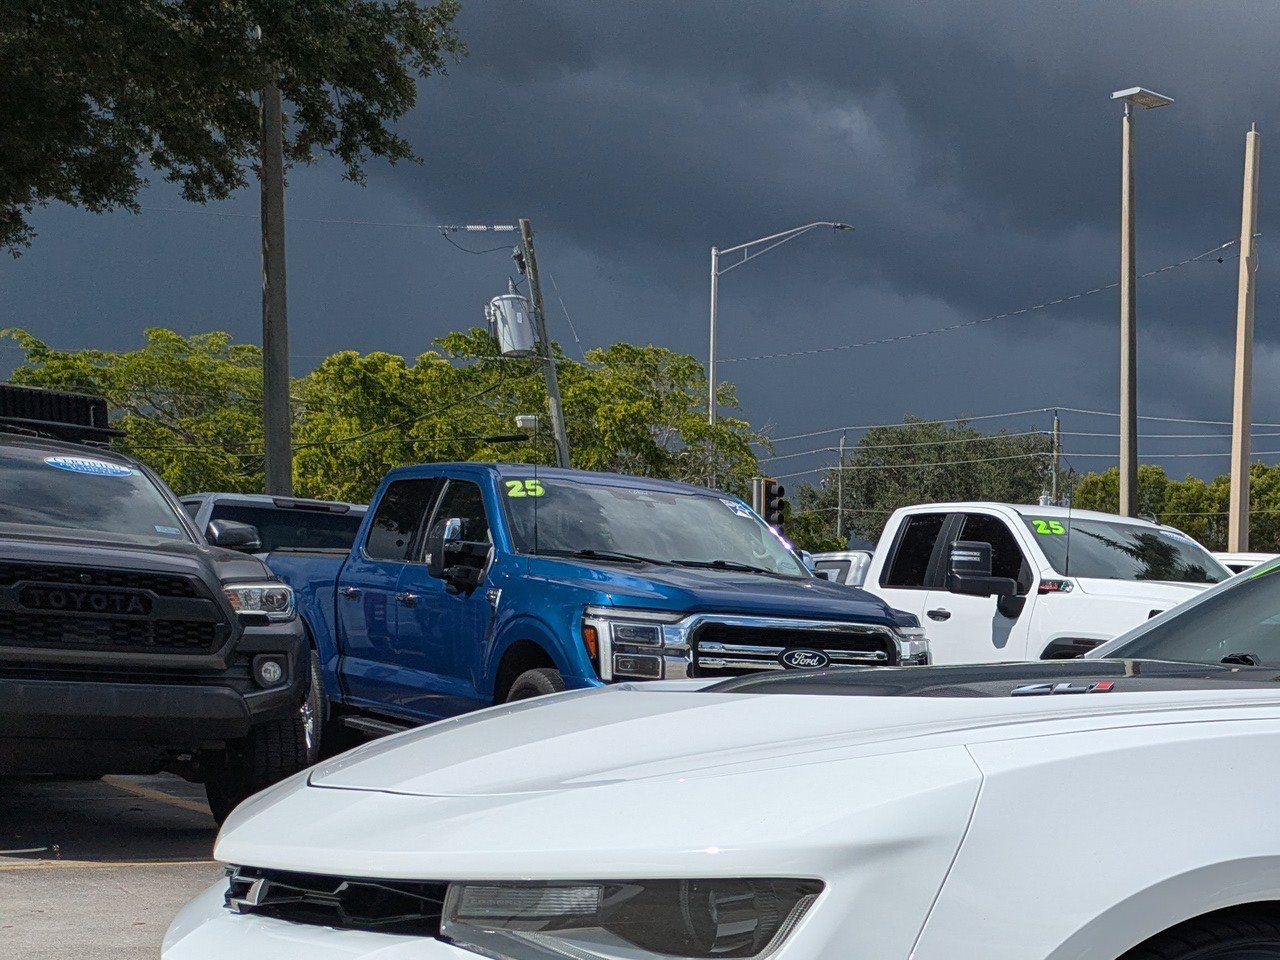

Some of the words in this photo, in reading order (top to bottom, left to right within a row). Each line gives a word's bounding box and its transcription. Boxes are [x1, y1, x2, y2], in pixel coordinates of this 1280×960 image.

[504, 479, 546, 498] 25
[1032, 519, 1067, 535] 25
[28, 589, 142, 613] TOYOTA
[791, 652, 820, 666] Ford
